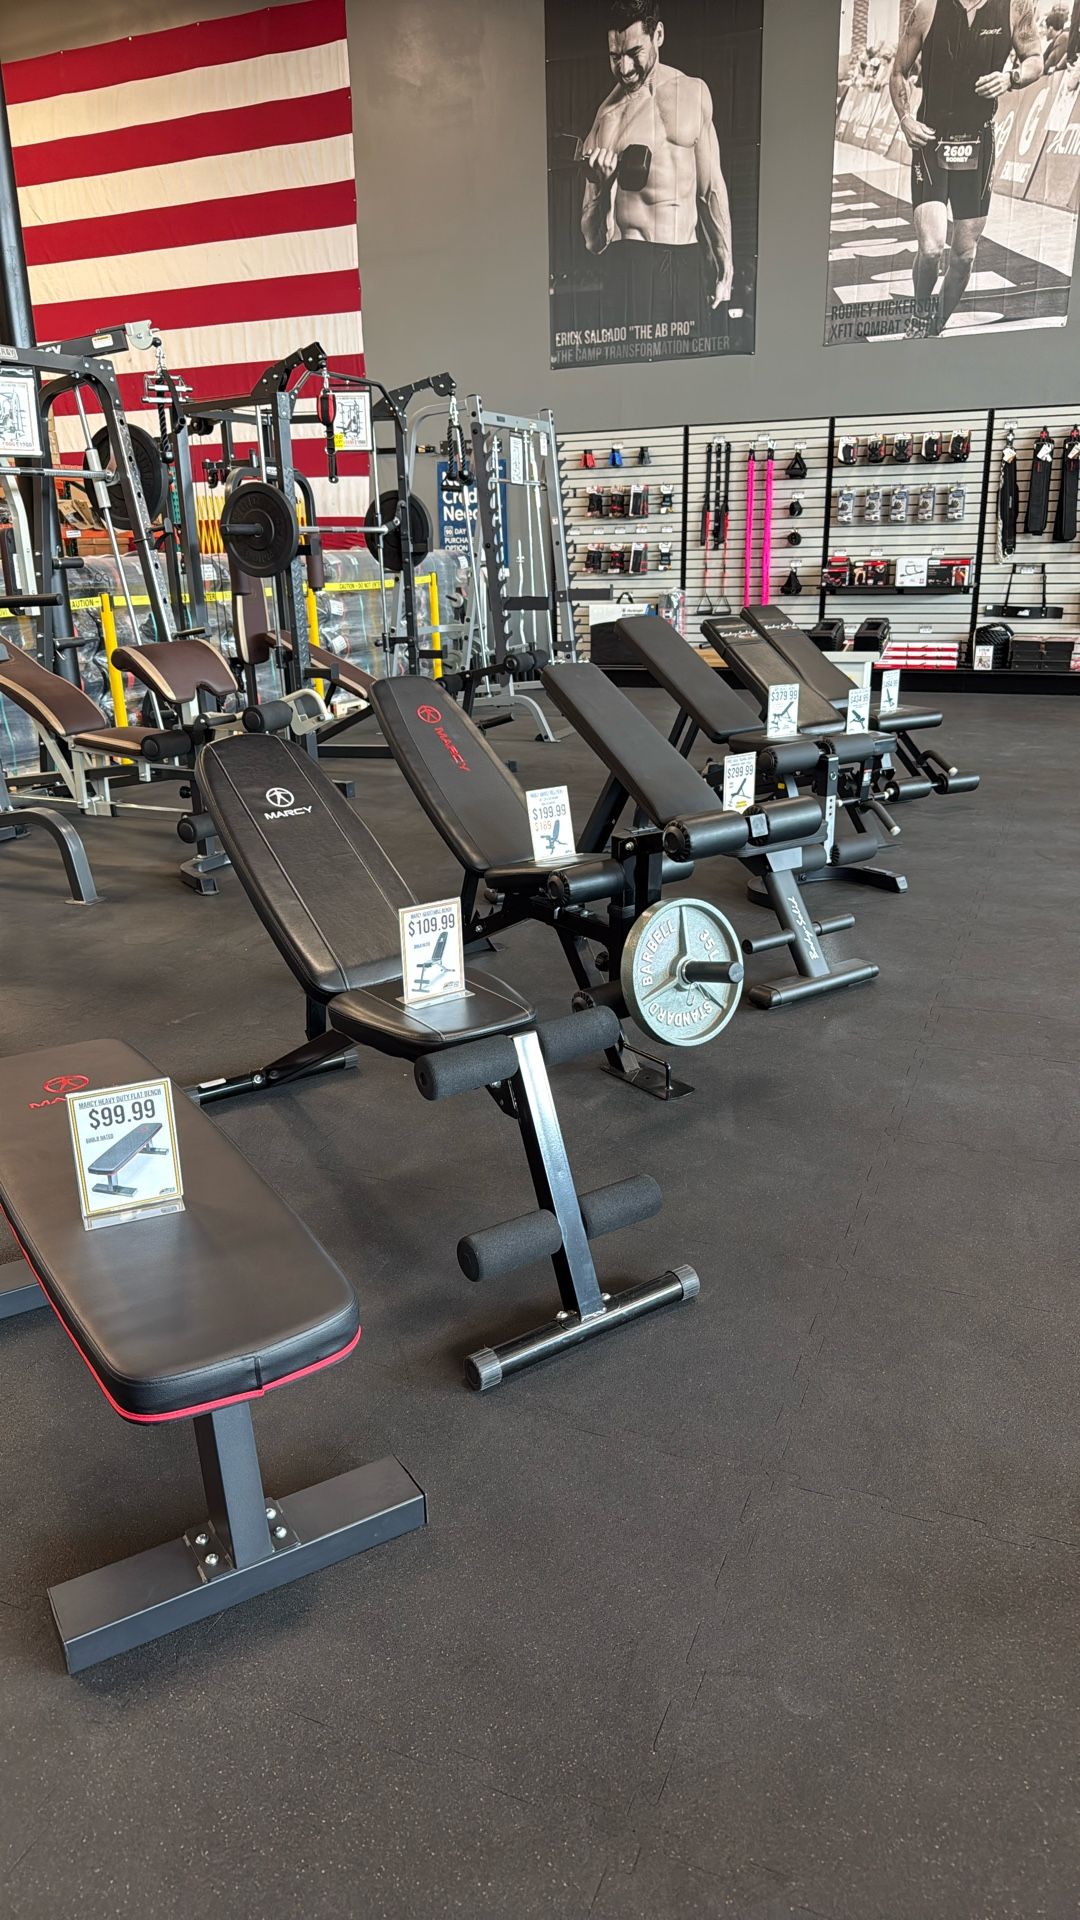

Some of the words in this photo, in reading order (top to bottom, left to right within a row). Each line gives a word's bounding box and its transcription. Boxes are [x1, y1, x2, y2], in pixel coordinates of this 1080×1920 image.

[943, 145, 973, 157] 2600
[831, 302, 874, 321] RODNEY
[877, 297, 940, 317] HICKERSON
[555, 330, 583, 347] ERICK
[584, 326, 627, 345] SALGADO
[629, 324, 653, 340] "THE
[655, 323, 668, 338] AB
[670, 320, 696, 336] PRO"
[830, 323, 853, 340] XFIT
[856, 319, 902, 337] COMBAT
[555, 349, 574, 364] THE
[575, 347, 601, 363] CAMP
[604, 339, 689, 360] TRANSFORMATION
[692, 336, 730, 353] CENTER
[71, 599, 94, 609] AUTION
[434, 726, 471, 772] MARCY
[264, 805, 312, 820] MARCY
[532, 803, 567, 821] $199.99
[408, 913, 455, 937] $109.99
[640, 919, 677, 987] BARBELL
[648, 1001, 713, 1027] STANDARD
[78, 1101, 98, 1110] MARCY
[98, 1096, 116, 1107] HEAVY
[116, 1094, 130, 1103] DUTY
[130, 1091, 143, 1100] FLAT
[88, 1098, 156, 1130] $99.99
